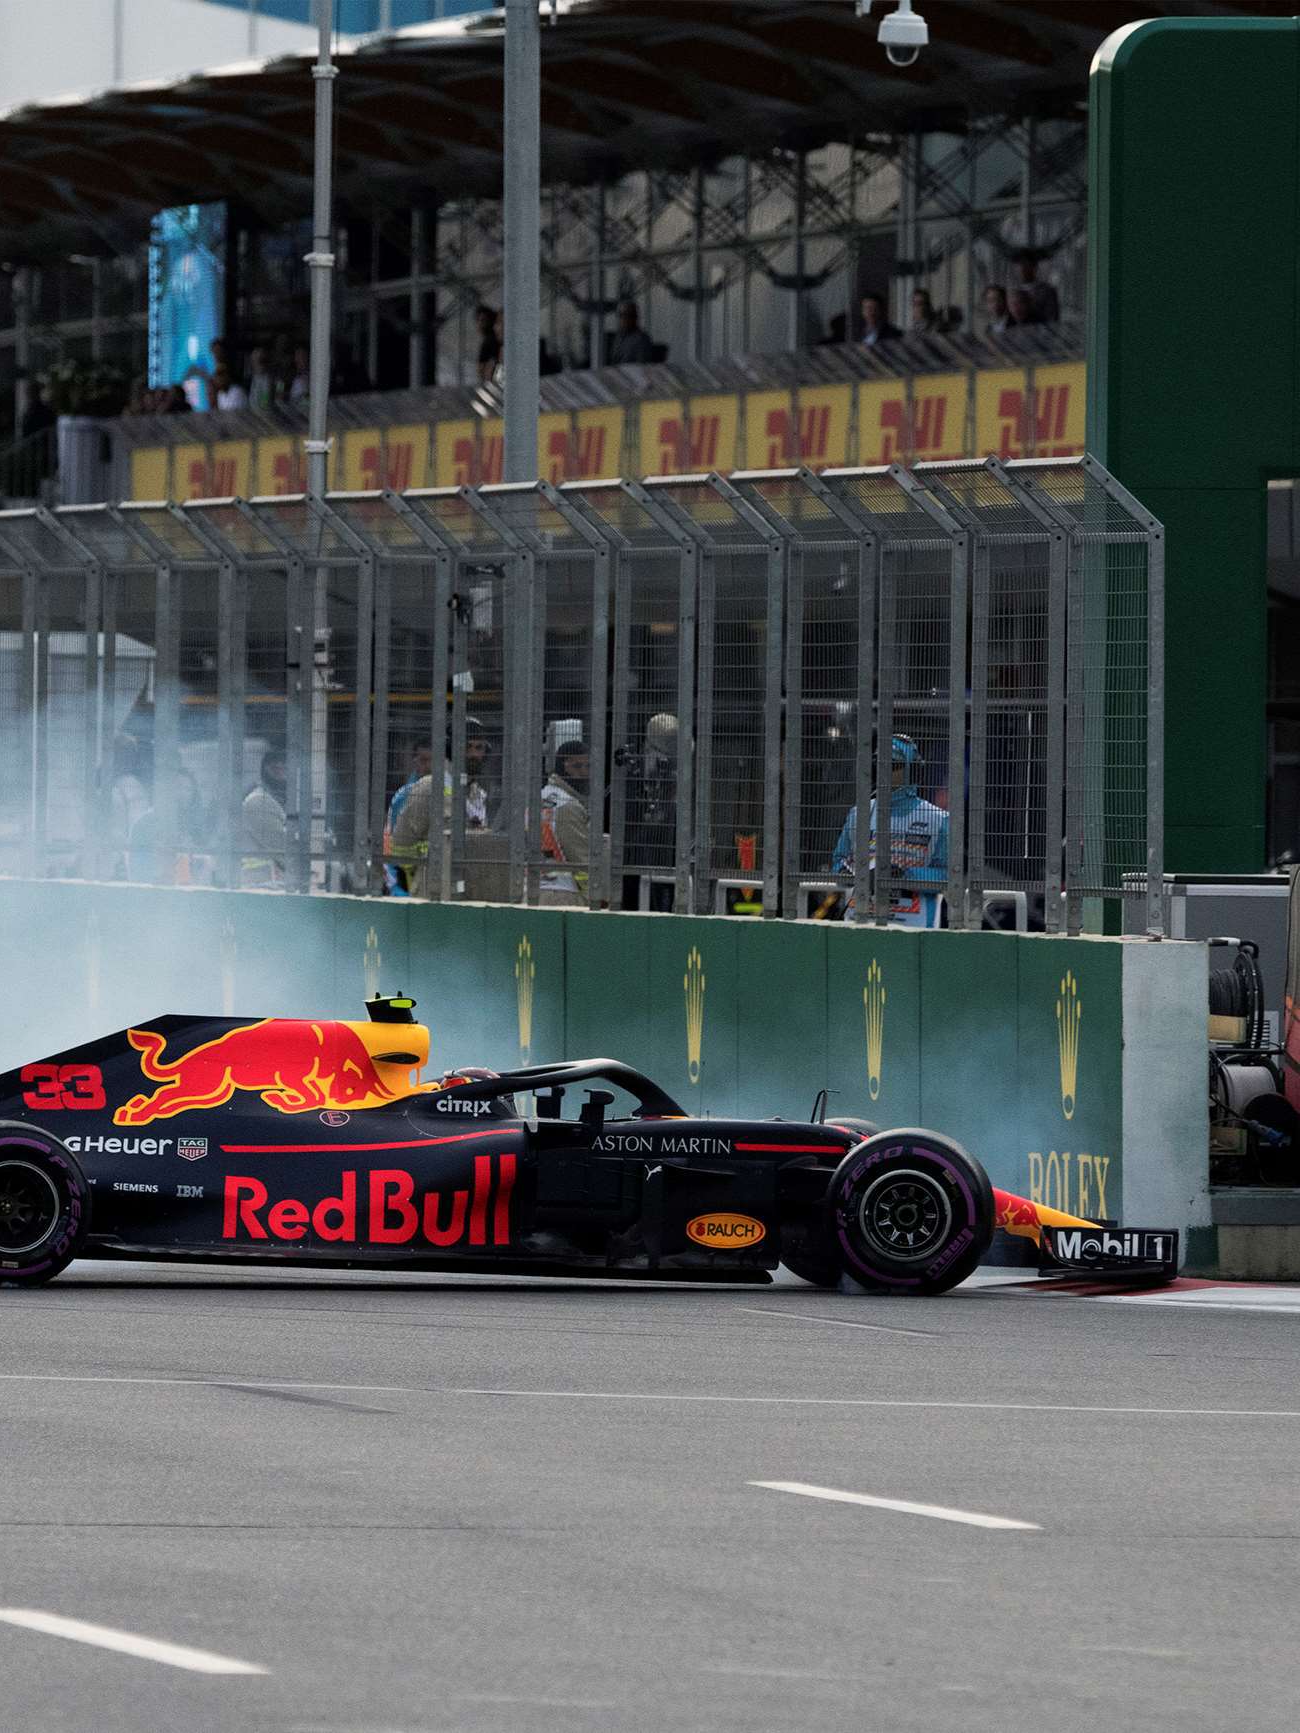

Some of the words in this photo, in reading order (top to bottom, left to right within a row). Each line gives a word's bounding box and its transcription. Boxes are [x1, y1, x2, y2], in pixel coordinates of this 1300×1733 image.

[20, 1063, 106, 1110] 33
[436, 1095, 492, 1117] CITRIX
[179, 1148, 205, 1158] HEUER
[591, 1136, 653, 1151] ASTON
[661, 1138, 731, 1154] MARTIN
[113, 1183, 159, 1193] SIEMENS
[176, 1185, 204, 1198] IBM
[1028, 1151, 1110, 1220] ROLEX
[706, 1223, 755, 1237] RAUCH
[1056, 1231, 1139, 1260] Mobil
[1153, 1237, 1163, 1260] 1
